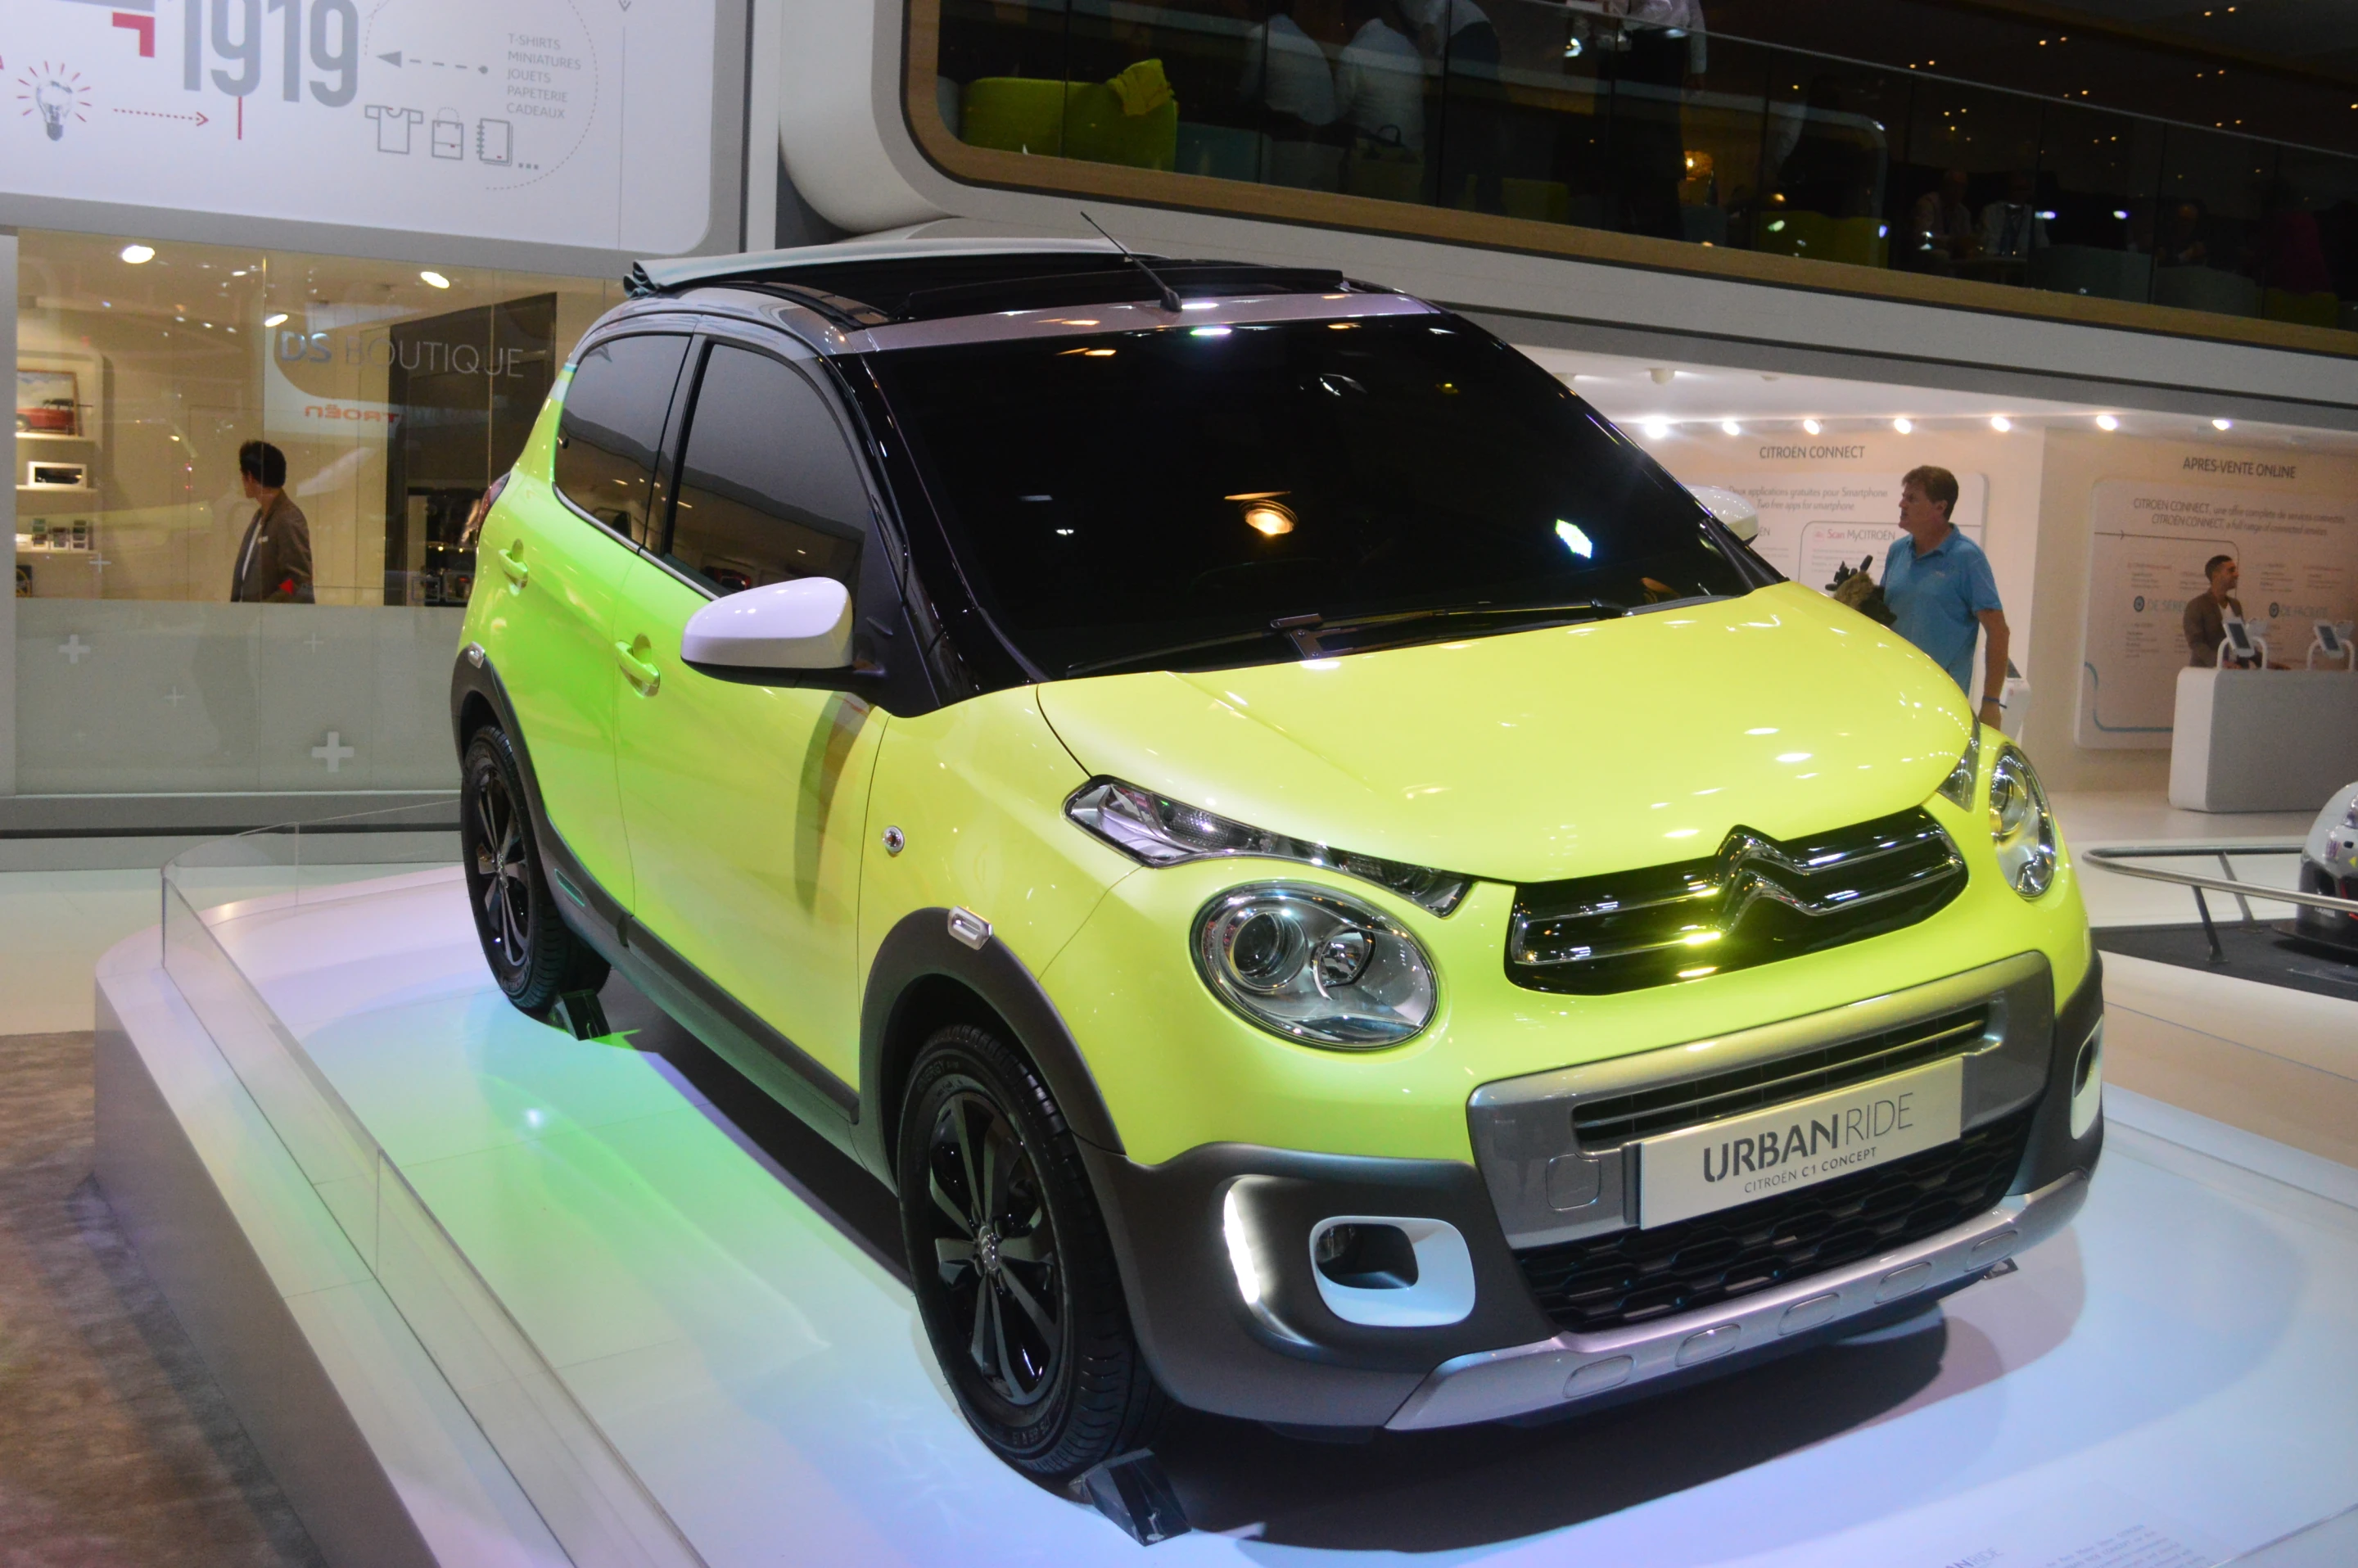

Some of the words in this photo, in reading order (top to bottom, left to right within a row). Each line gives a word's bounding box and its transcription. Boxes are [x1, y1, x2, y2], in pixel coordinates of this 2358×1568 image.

[507, 33, 562, 51] T-SHIRTS
[182, 0, 359, 108] 1919
[507, 50, 582, 71] MINIATURES
[506, 68, 552, 84] JOUETS
[506, 84, 569, 104] PAPETERIE
[505, 102, 566, 120] CADEAUX
[280, 330, 332, 364] DS
[345, 335, 524, 378] BOUTIQUE
[1809, 445, 1866, 459] CONNECT
[2256, 463, 2297, 479] ONLINE
[1823, 490, 1840, 499] pour
[1827, 528, 1845, 540] Scan
[1744, 1168, 1798, 1193] CITROËN
[1800, 1164, 1818, 1178] C1
[1821, 1146, 1877, 1172] CONCEPT
